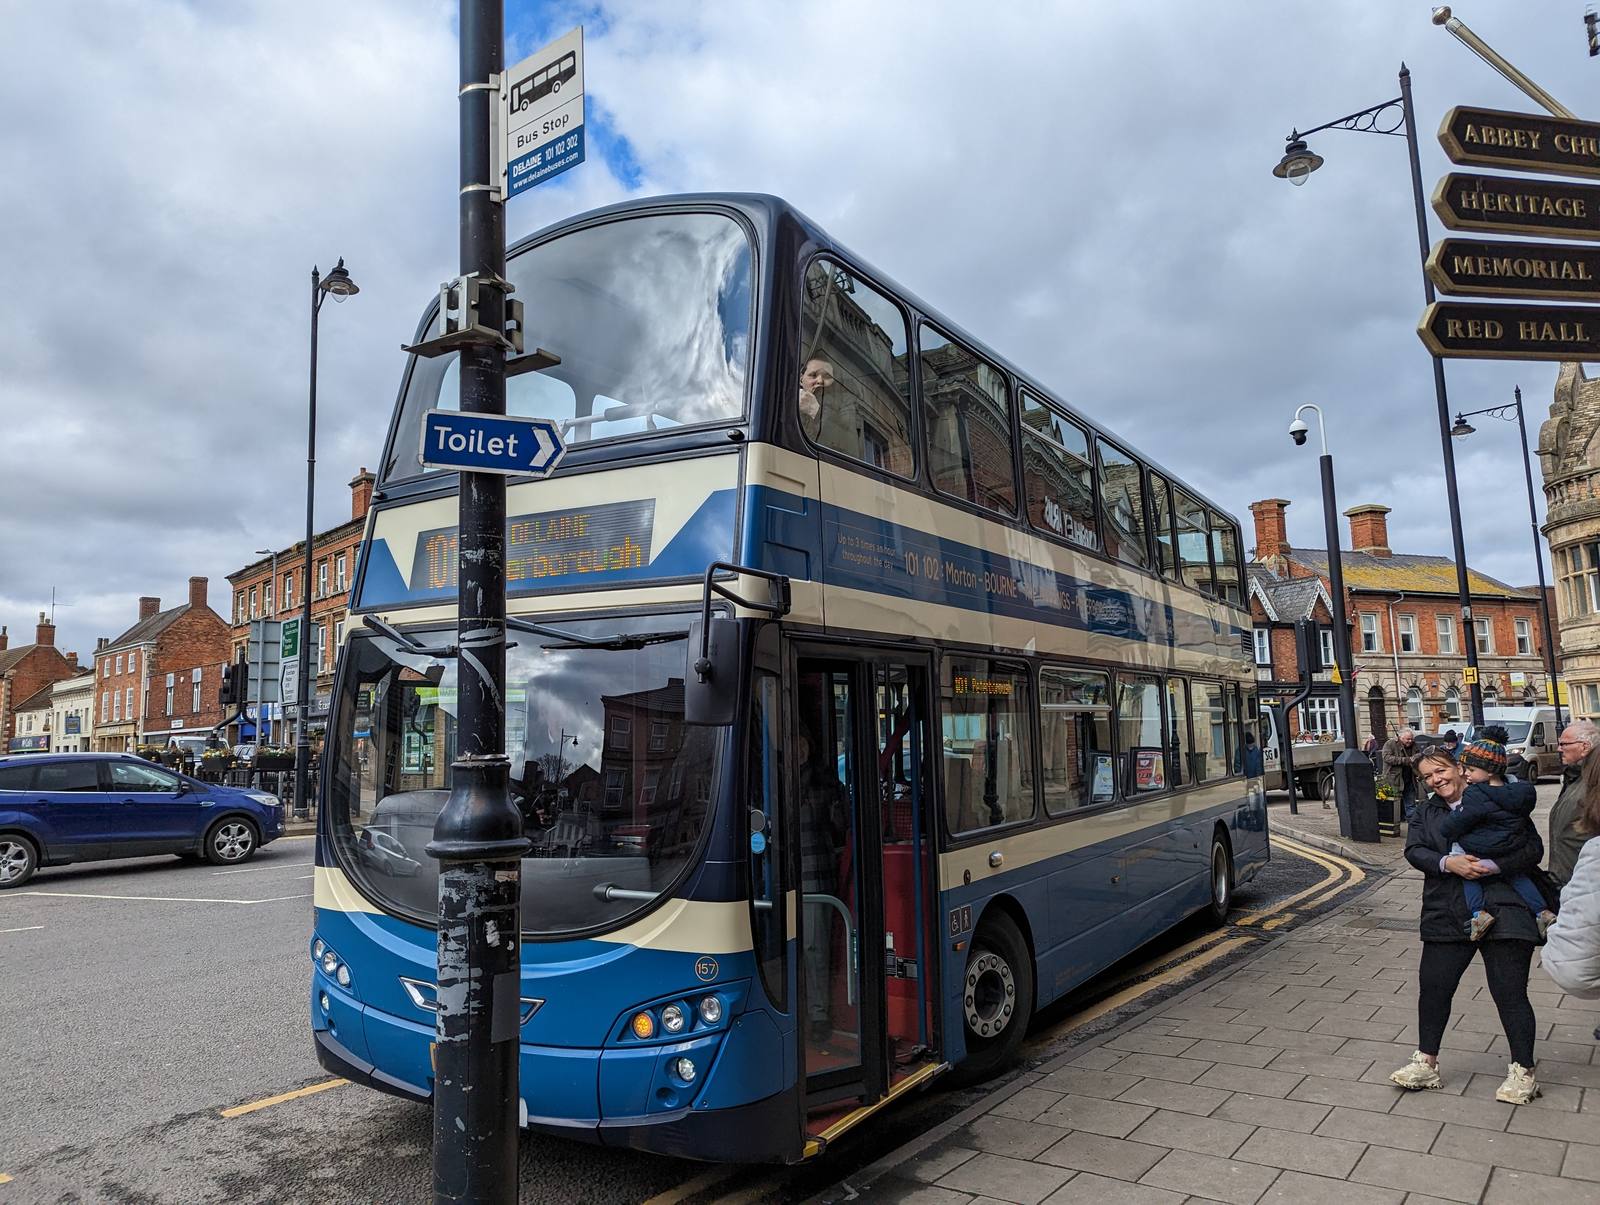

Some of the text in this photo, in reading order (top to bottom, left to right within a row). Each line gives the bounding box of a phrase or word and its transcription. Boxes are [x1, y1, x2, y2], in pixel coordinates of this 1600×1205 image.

[517, 114, 569, 149] Bus Stop
[1464, 123, 1541, 150] ABBEY
[512, 133, 578, 178] DELAINE 101 102 302
[513, 152, 579, 189] www.delainebuses.com
[1460, 190, 1587, 218] HERITAGE
[1453, 255, 1592, 281] MEMORIAL
[1446, 318, 1590, 342] RED HALL
[433, 425, 519, 457] Toilet
[511, 514, 593, 546] DELAINE
[506, 536, 641, 582] erborough
[904, 551, 919, 576] 101
[945, 561, 977, 589] Morton
[984, 571, 1018, 598] BOURNE
[1464, 669, 1476, 682] H
[697, 962, 716, 975] 157
